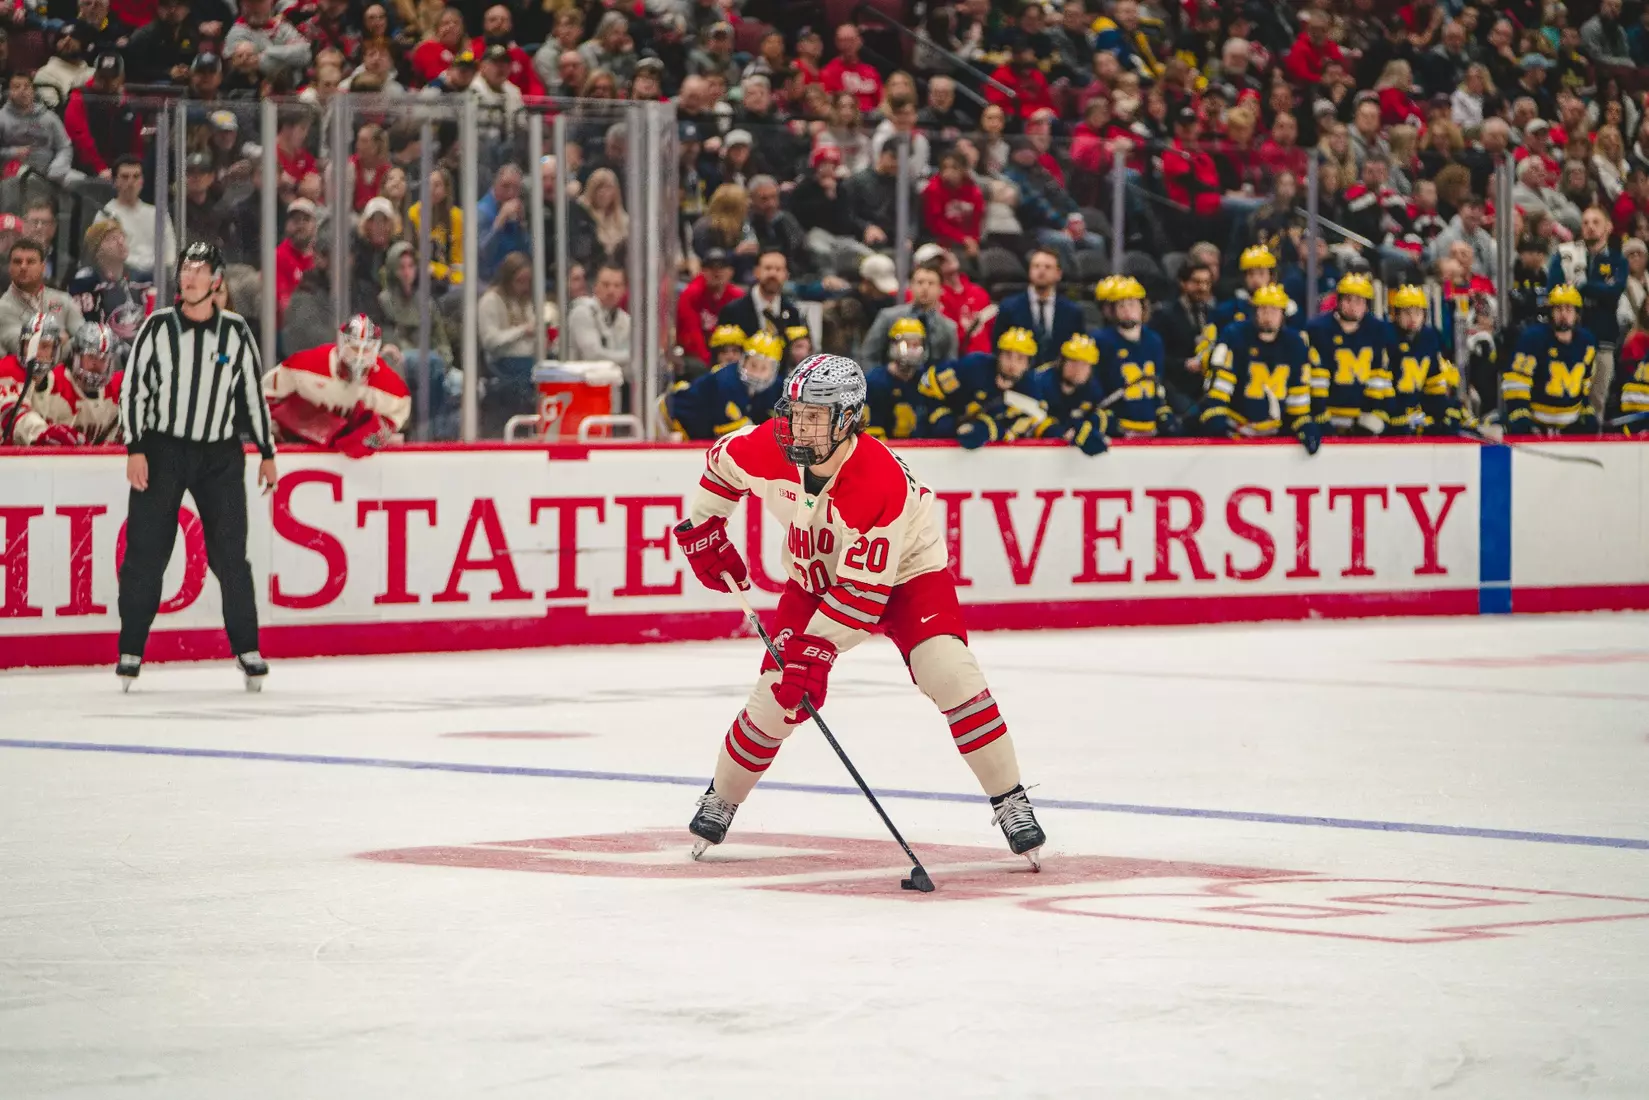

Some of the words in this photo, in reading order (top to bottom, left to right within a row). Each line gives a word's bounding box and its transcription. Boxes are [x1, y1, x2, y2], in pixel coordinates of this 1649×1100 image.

[1243, 361, 1291, 400] M
[1334, 346, 1374, 385] M
[1544, 360, 1586, 398] M
[269, 469, 684, 610] STATE
[745, 484, 1467, 594] UIVERSITY
[681, 529, 721, 555] UER
[787, 520, 835, 560] OHIO
[844, 535, 891, 574] 20
